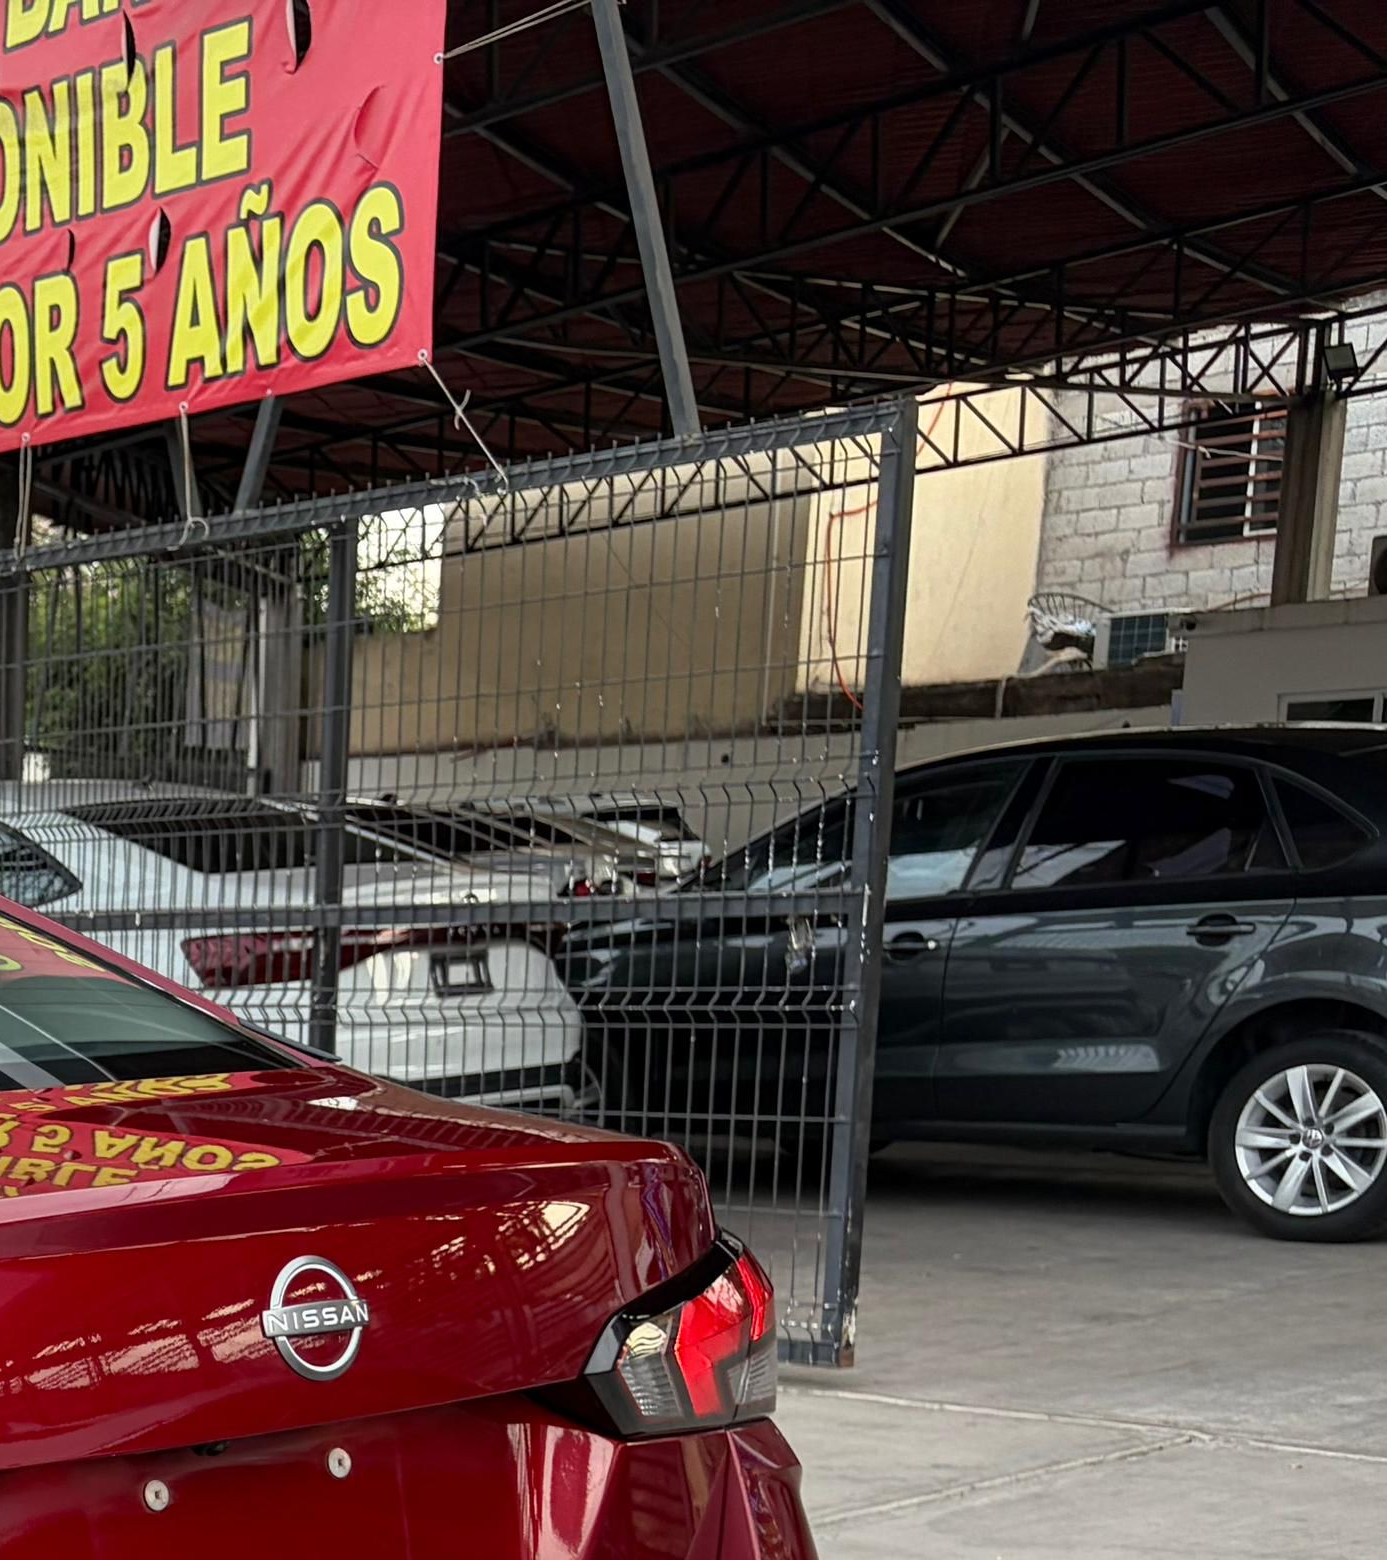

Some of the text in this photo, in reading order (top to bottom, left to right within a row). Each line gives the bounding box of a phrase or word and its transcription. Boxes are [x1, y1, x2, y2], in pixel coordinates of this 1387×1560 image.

[100, 252, 146, 403] 5
[164, 178, 405, 391] AÑOS
[266, 1303, 370, 1334] NISSAN
